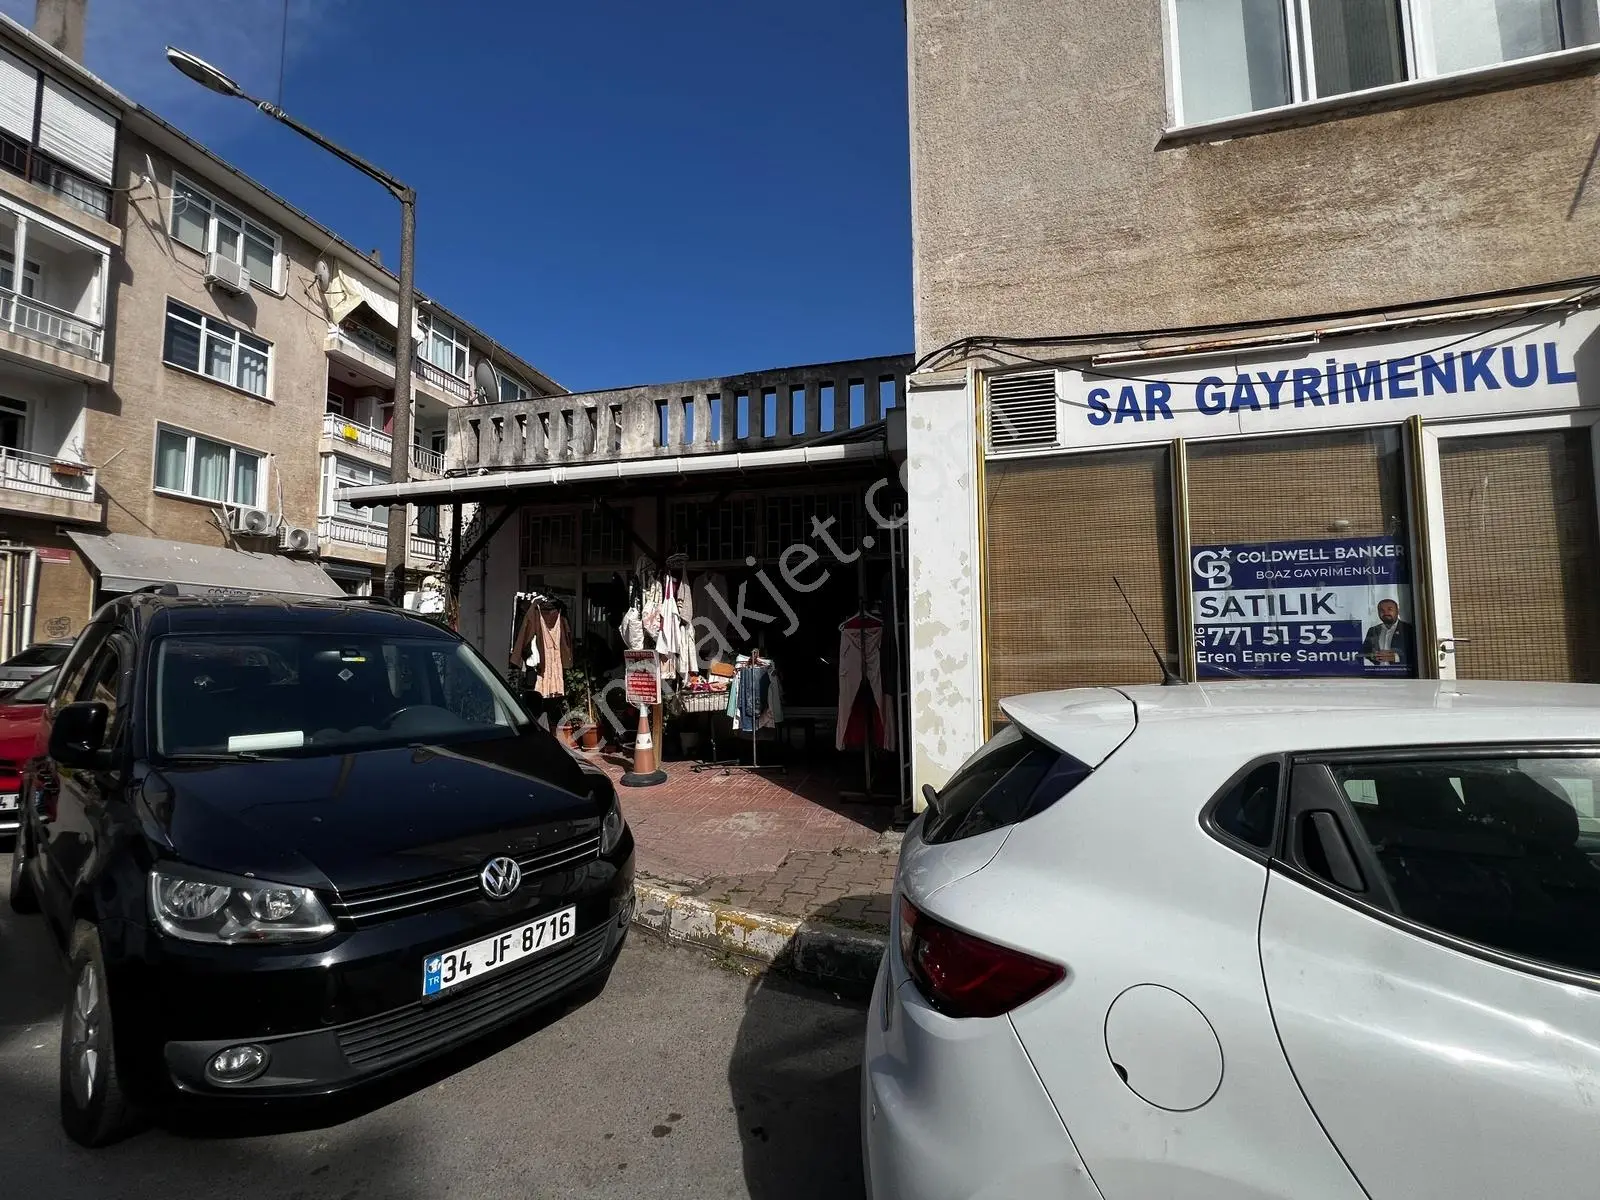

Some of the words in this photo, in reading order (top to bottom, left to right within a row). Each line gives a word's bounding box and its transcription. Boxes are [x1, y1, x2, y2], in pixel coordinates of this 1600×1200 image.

[1087, 382, 1174, 426] SAR
[1195, 341, 1577, 415] GAYRİMENKUL
[1236, 548, 1330, 564] COLDWELL
[1335, 544, 1405, 559] BANKER
[1256, 569, 1291, 580] BOAZ
[1294, 566, 1389, 578] GAYRİMENKUL
[1200, 592, 1336, 618] SATILIK
[1207, 626, 1253, 646] 771
[1262, 626, 1289, 645] 51
[1300, 624, 1333, 645] 53
[1197, 650, 1237, 663] Eren
[1243, 649, 1292, 663] Emre
[1296, 649, 1359, 662] Samur
[442, 950, 472, 983] 34
[485, 933, 512, 967] JF
[522, 912, 570, 952] 8716
[428, 975, 440, 987] TR
